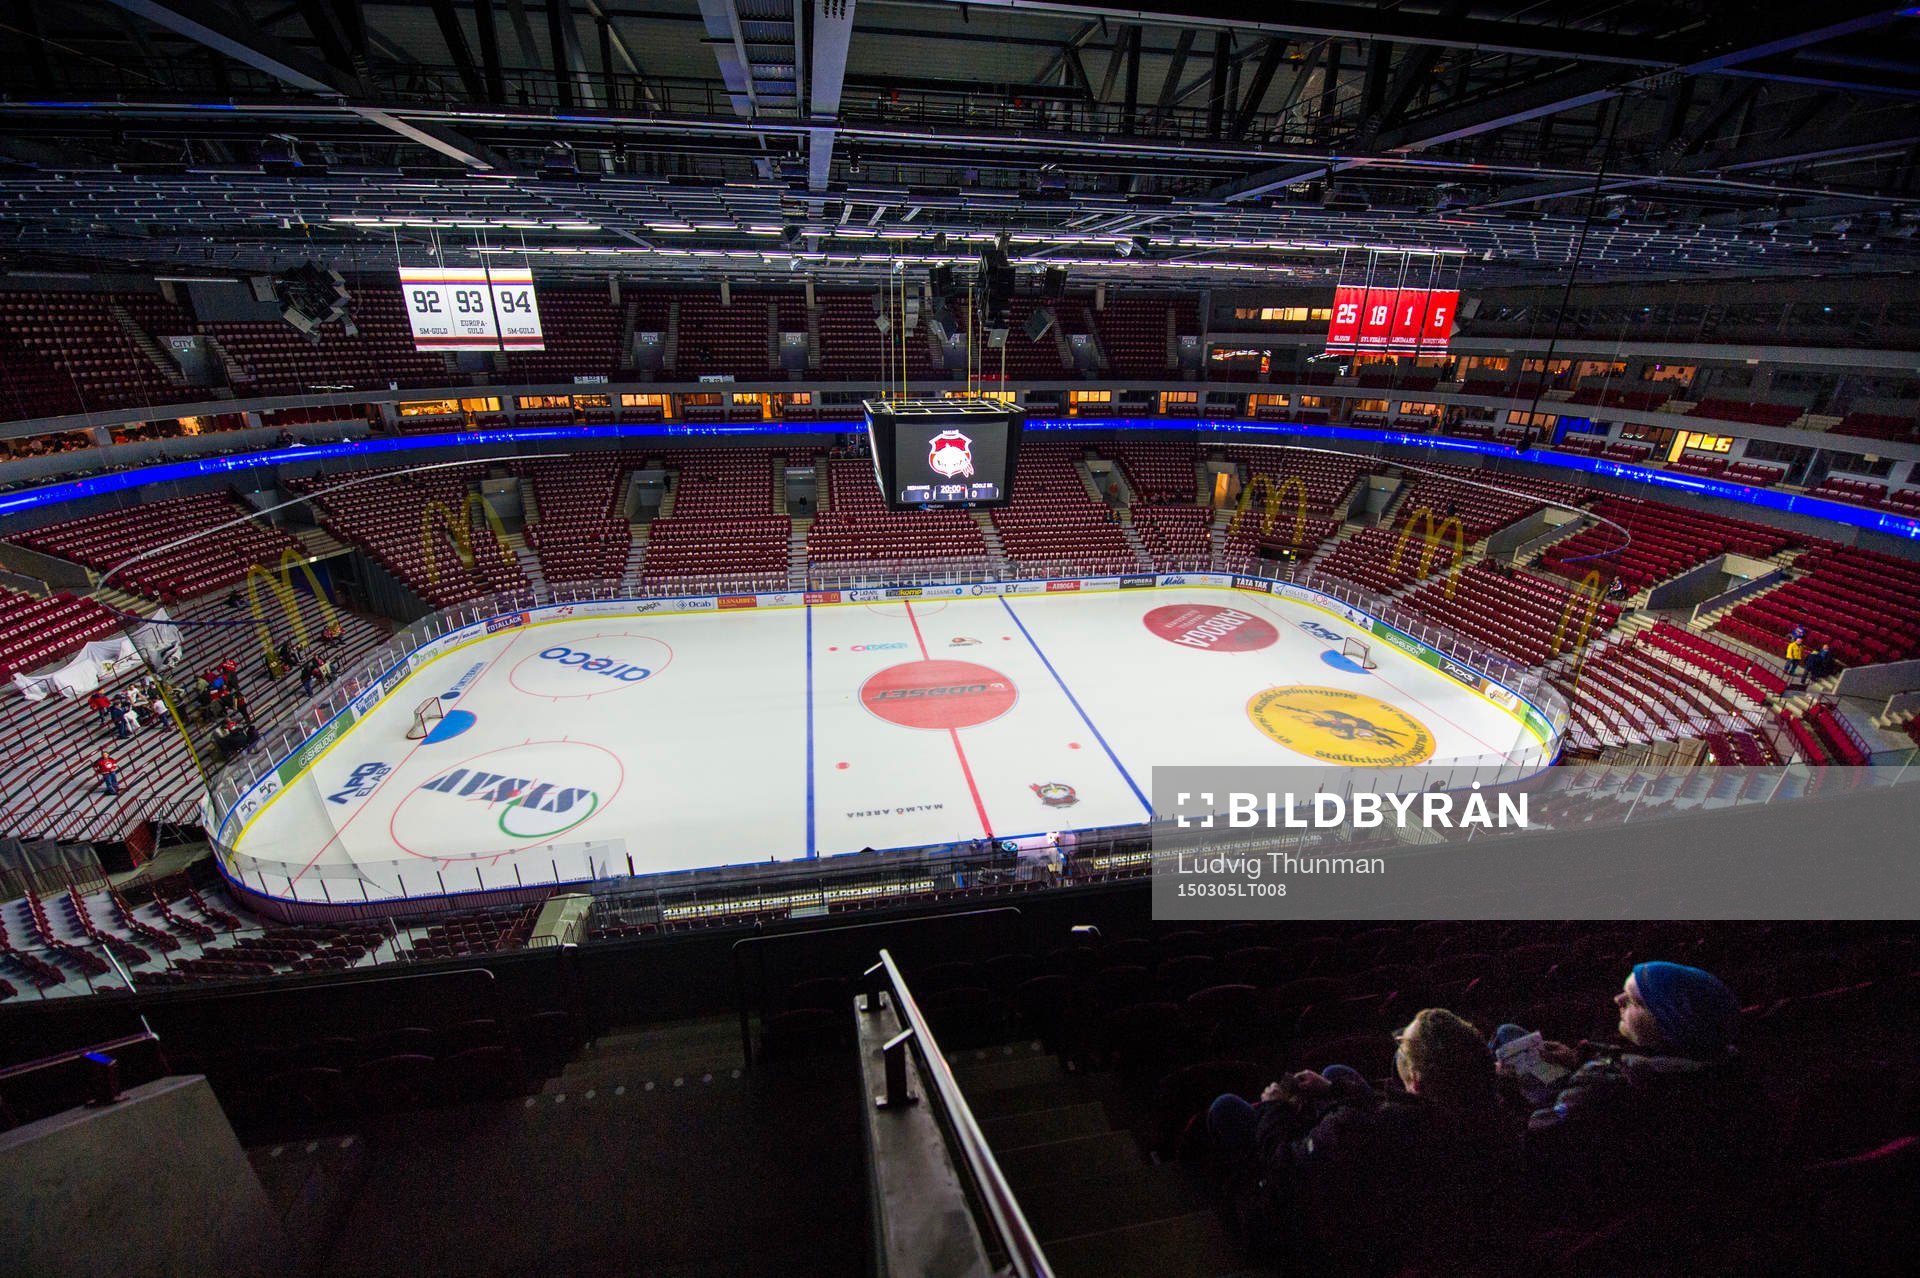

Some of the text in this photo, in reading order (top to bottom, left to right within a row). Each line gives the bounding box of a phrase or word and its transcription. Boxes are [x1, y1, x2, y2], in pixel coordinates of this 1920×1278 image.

[413, 291, 442, 313] 92
[456, 291, 484, 313] 93
[501, 291, 531, 313] 94
[1336, 304, 1358, 324] 25
[1369, 305, 1387, 326] 18
[1404, 306, 1413, 326] 1
[1434, 308, 1446, 327] 5
[173, 340, 192, 348] CITY
[941, 485, 960, 493] 20:00
[1005, 584, 1018, 593] EY
[1255, 580, 1268, 589] TAK
[688, 600, 711, 608] Ocab
[487, 615, 522, 632] TOTALLACK
[1174, 609, 1253, 647] ARBOGA
[539, 647, 651, 681] areco
[384, 665, 410, 691] stadium
[871, 684, 987, 701] ODDSET
[300, 731, 336, 767] CASHBUDDY
[355, 767, 391, 797] EL AB
[847, 804, 943, 818] MALMÖ ARENA
